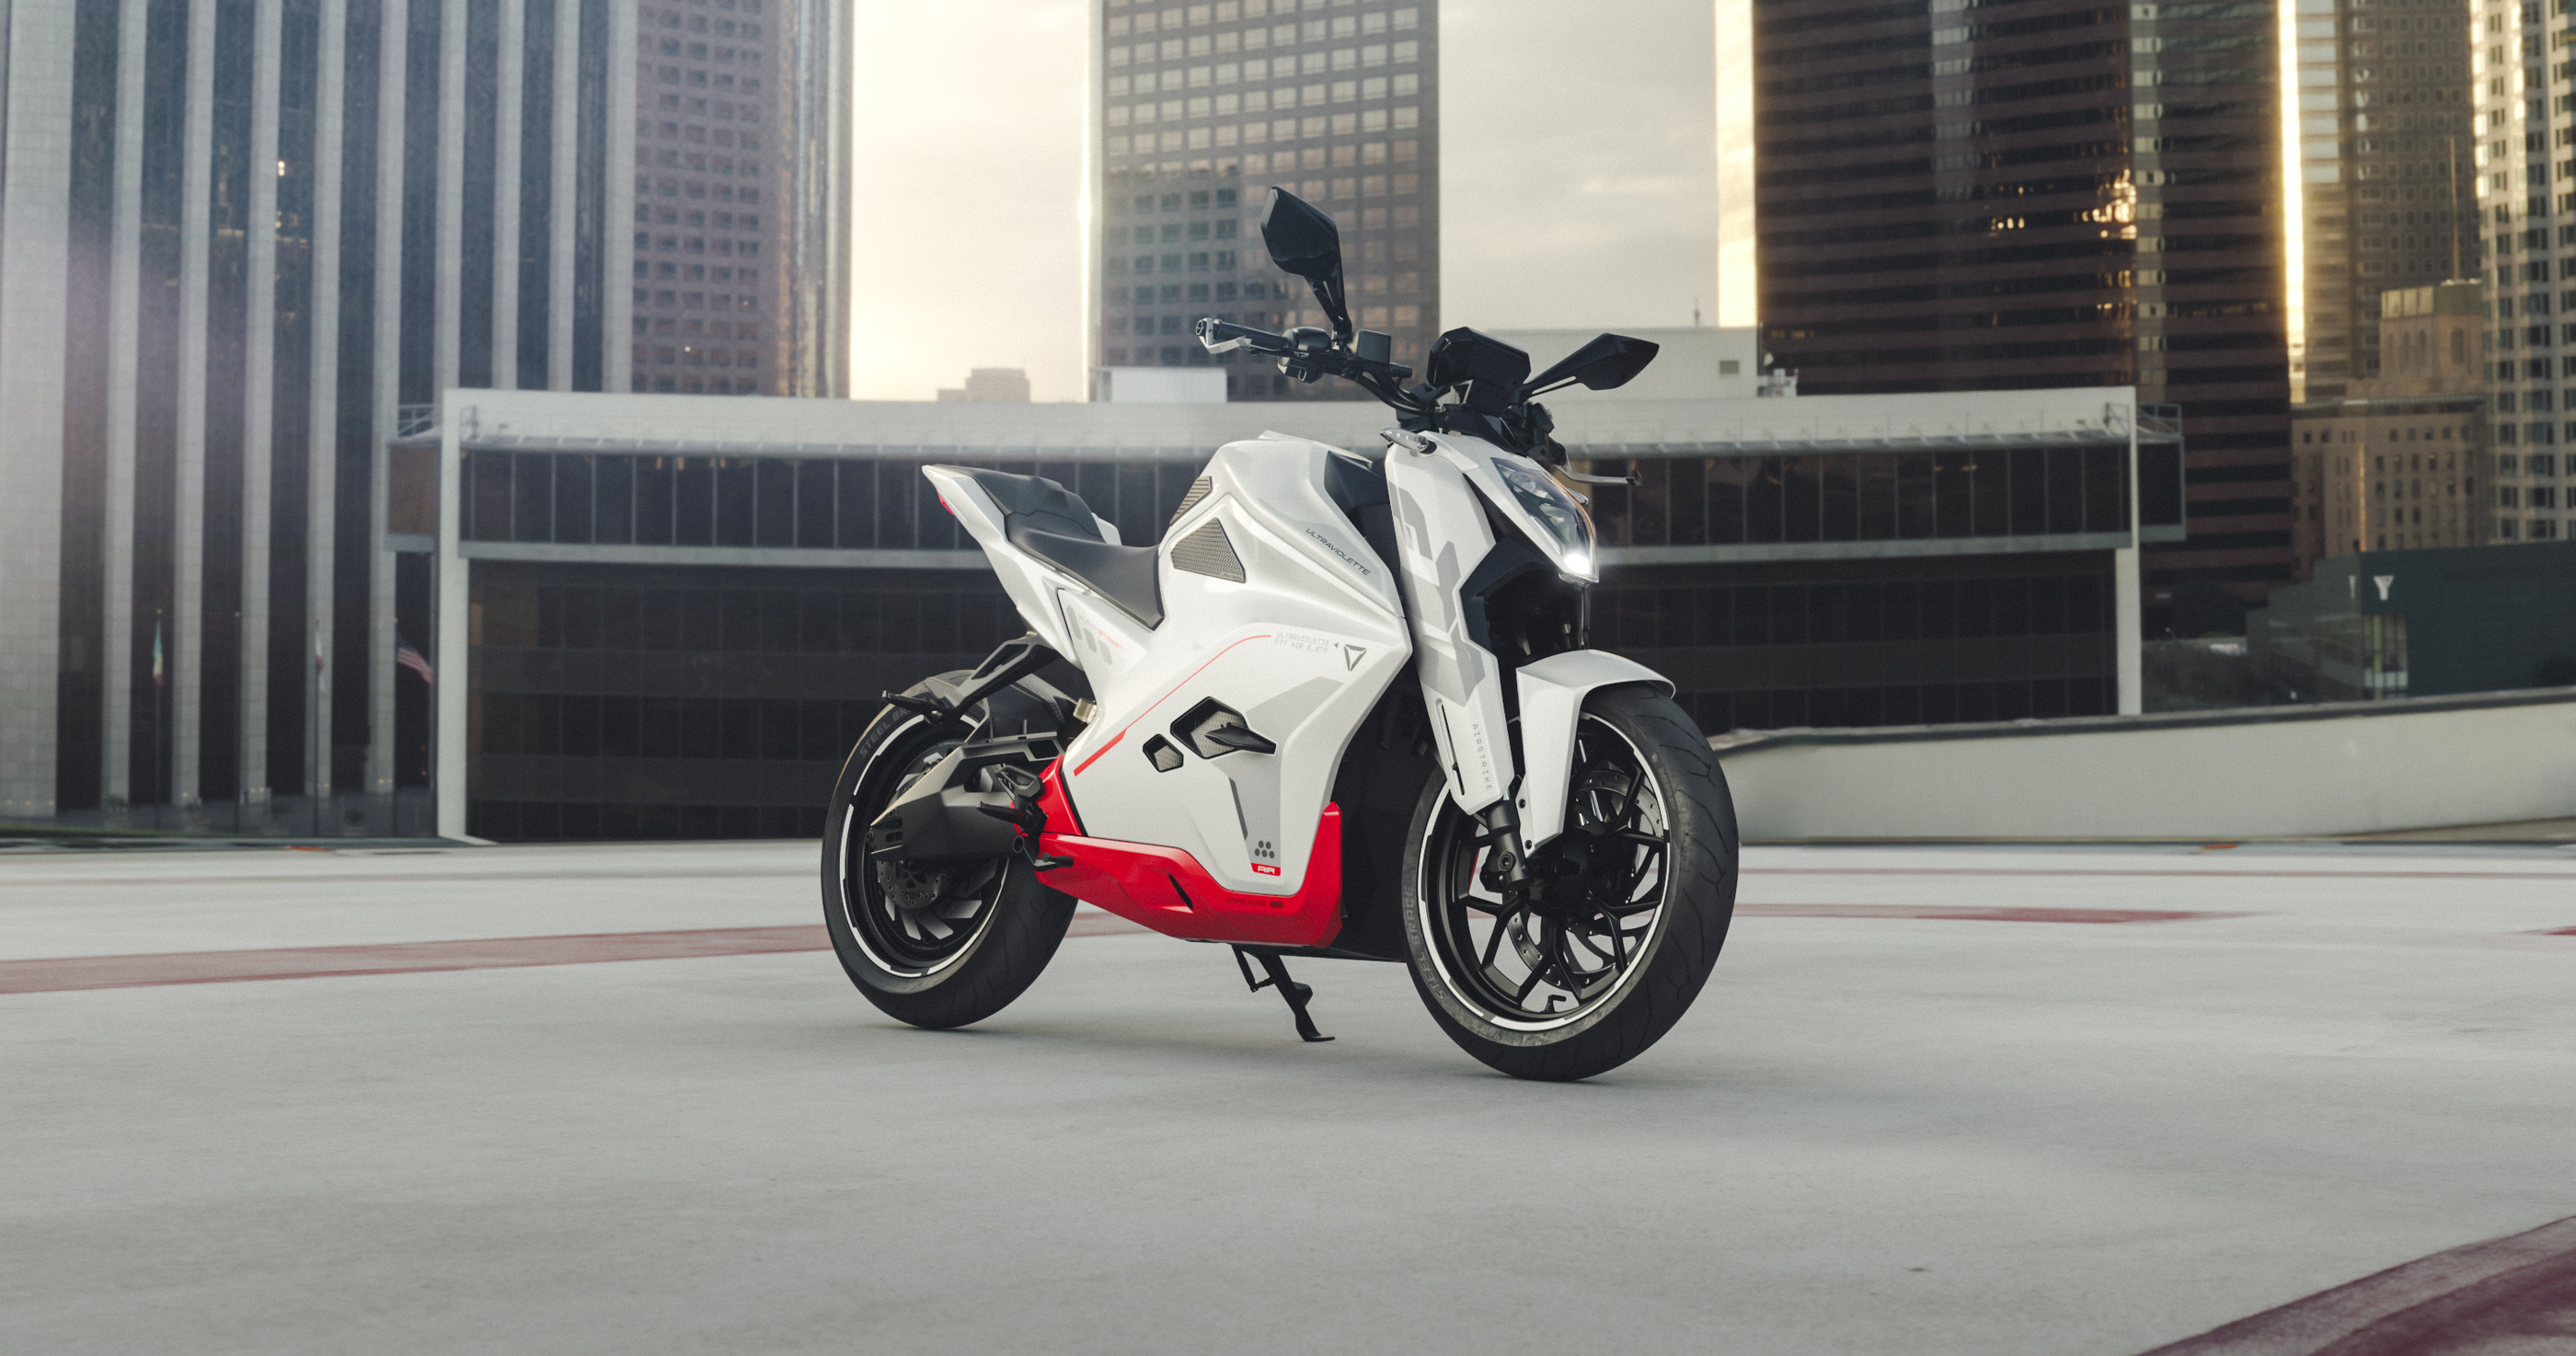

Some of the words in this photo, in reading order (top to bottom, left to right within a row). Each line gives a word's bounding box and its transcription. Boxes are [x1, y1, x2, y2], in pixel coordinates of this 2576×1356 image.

[1305, 528, 1371, 576] ULTRAVIOLETTE
[1276, 631, 1329, 647] ULTRAVIOLETTE
[859, 721, 891, 758] STEEL
[1472, 723, 1492, 791] AIRSTRIKE
[1258, 866, 1275, 875] AIR
[1227, 897, 1245, 905] STAND
[1404, 886, 1420, 946] BRACE
[1418, 951, 1448, 1000] STEEL
